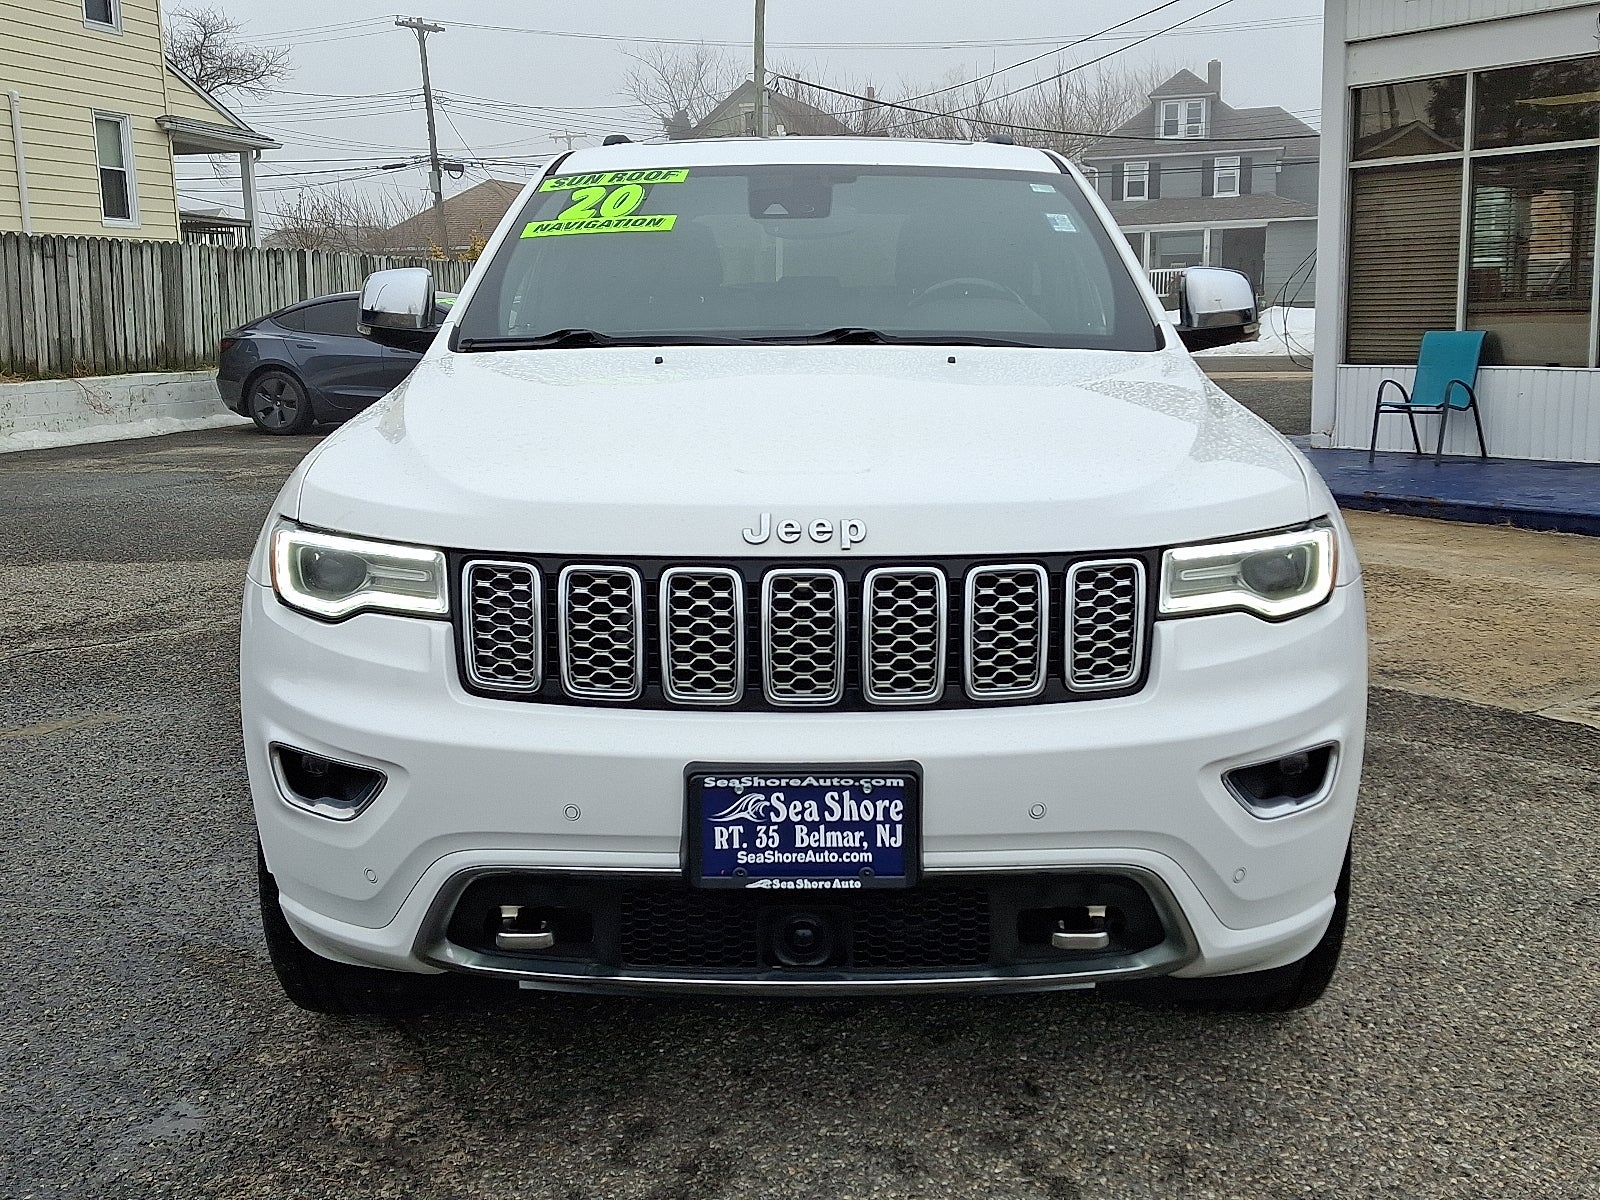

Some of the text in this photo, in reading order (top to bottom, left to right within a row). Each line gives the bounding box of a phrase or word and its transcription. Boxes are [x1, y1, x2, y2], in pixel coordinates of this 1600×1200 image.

[550, 170, 682, 188] SUN ROOF
[557, 184, 646, 221] 20
[533, 217, 666, 233] NAVIGATION
[742, 512, 867, 550] Jeep
[704, 776, 904, 788] SeaShoreAuto.com
[770, 790, 904, 822] Sea Shore
[714, 824, 903, 850] RT. 35 Belmar, NJ
[737, 850, 873, 864] SeaShoreAuto.com
[772, 878, 862, 889] Sea Shore Auto
